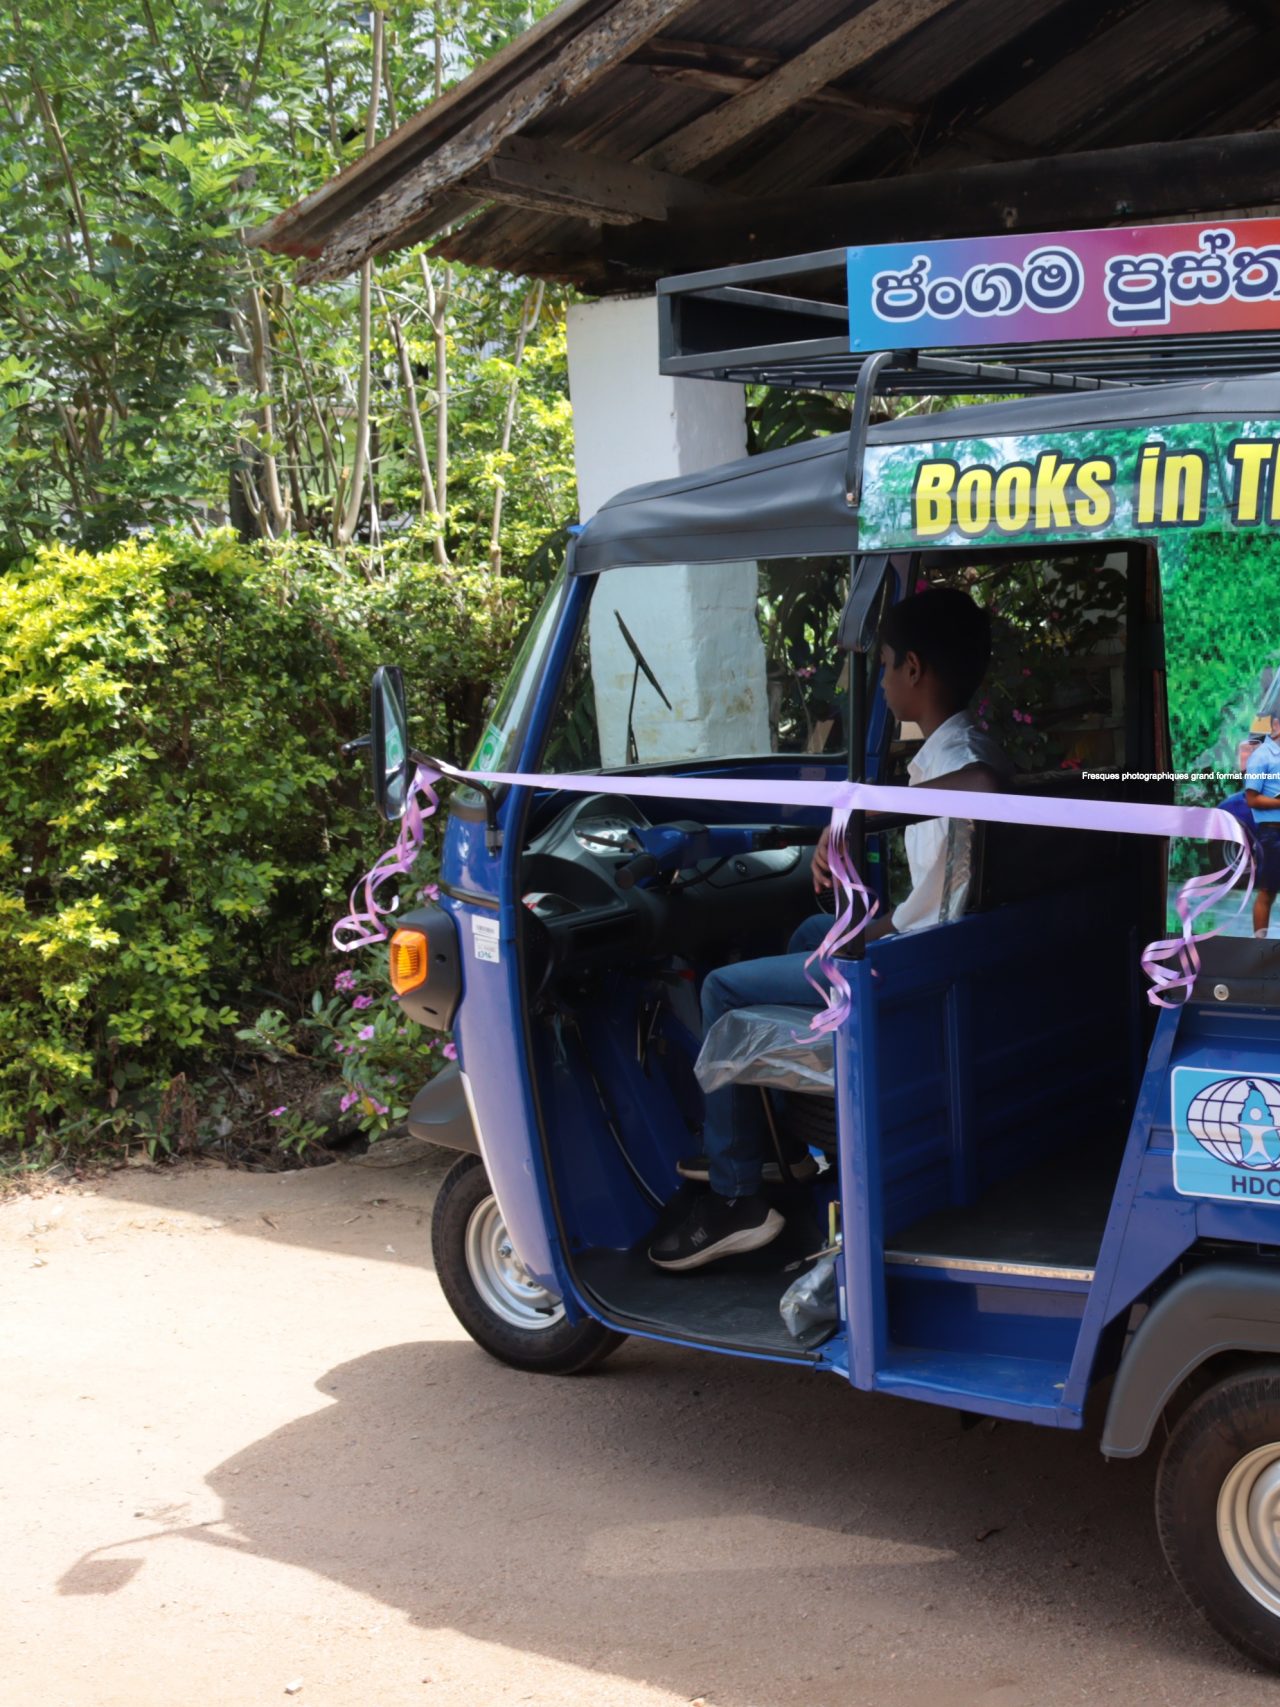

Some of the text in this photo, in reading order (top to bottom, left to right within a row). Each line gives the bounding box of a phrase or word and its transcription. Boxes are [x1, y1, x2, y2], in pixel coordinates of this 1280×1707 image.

[873, 247, 1084, 322] ජංගම
[913, 456, 1114, 538] Books
[1137, 446, 1206, 528] in
